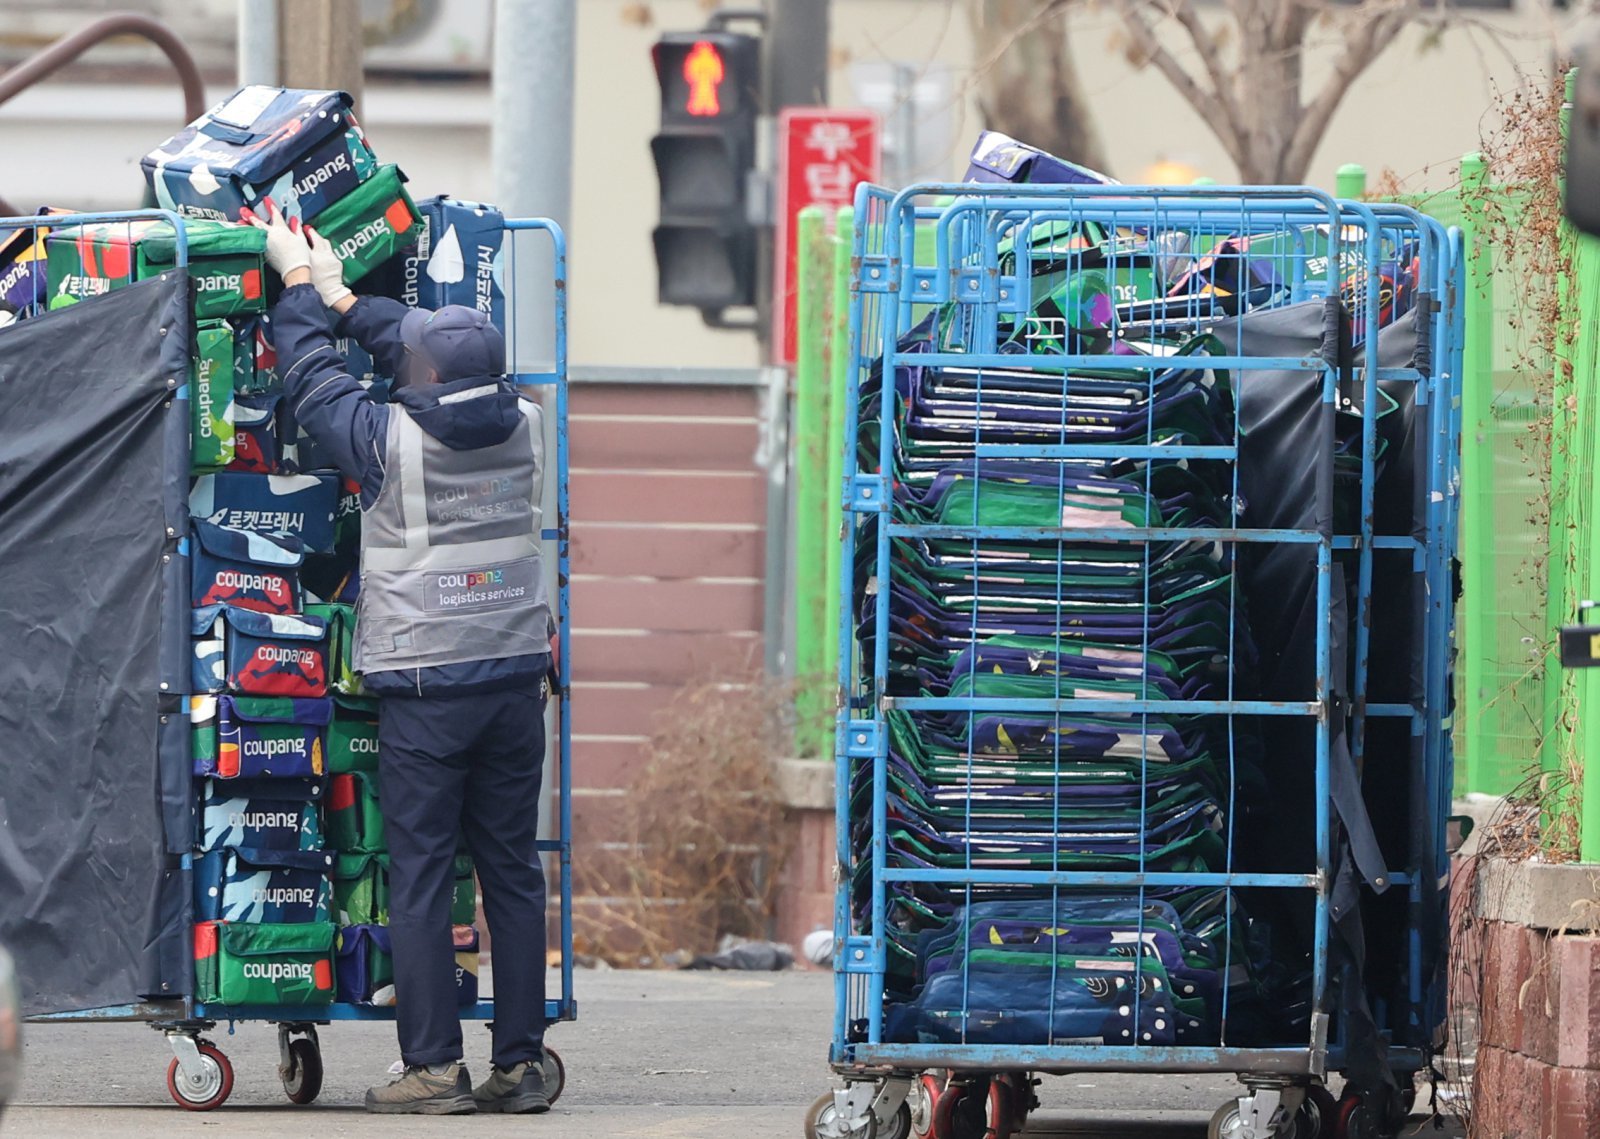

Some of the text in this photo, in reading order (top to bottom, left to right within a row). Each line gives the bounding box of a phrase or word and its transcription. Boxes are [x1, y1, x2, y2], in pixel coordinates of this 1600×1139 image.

[280, 153, 350, 206] coupang
[805, 122, 857, 228] 무단
[333, 216, 390, 260] upang
[0, 261, 30, 300] pang
[476, 245, 493, 321] 켓프레시
[198, 358, 213, 438] coupang
[228, 511, 304, 531] 로켓프레시
[215, 571, 282, 597] coupang
[438, 569, 503, 590] coupang
[439, 585, 525, 606] logistics services
[257, 646, 315, 668] coupang
[244, 737, 306, 759] coupang
[229, 811, 298, 832] coupang
[252, 886, 314, 908] coupang
[243, 961, 313, 983] coupang
